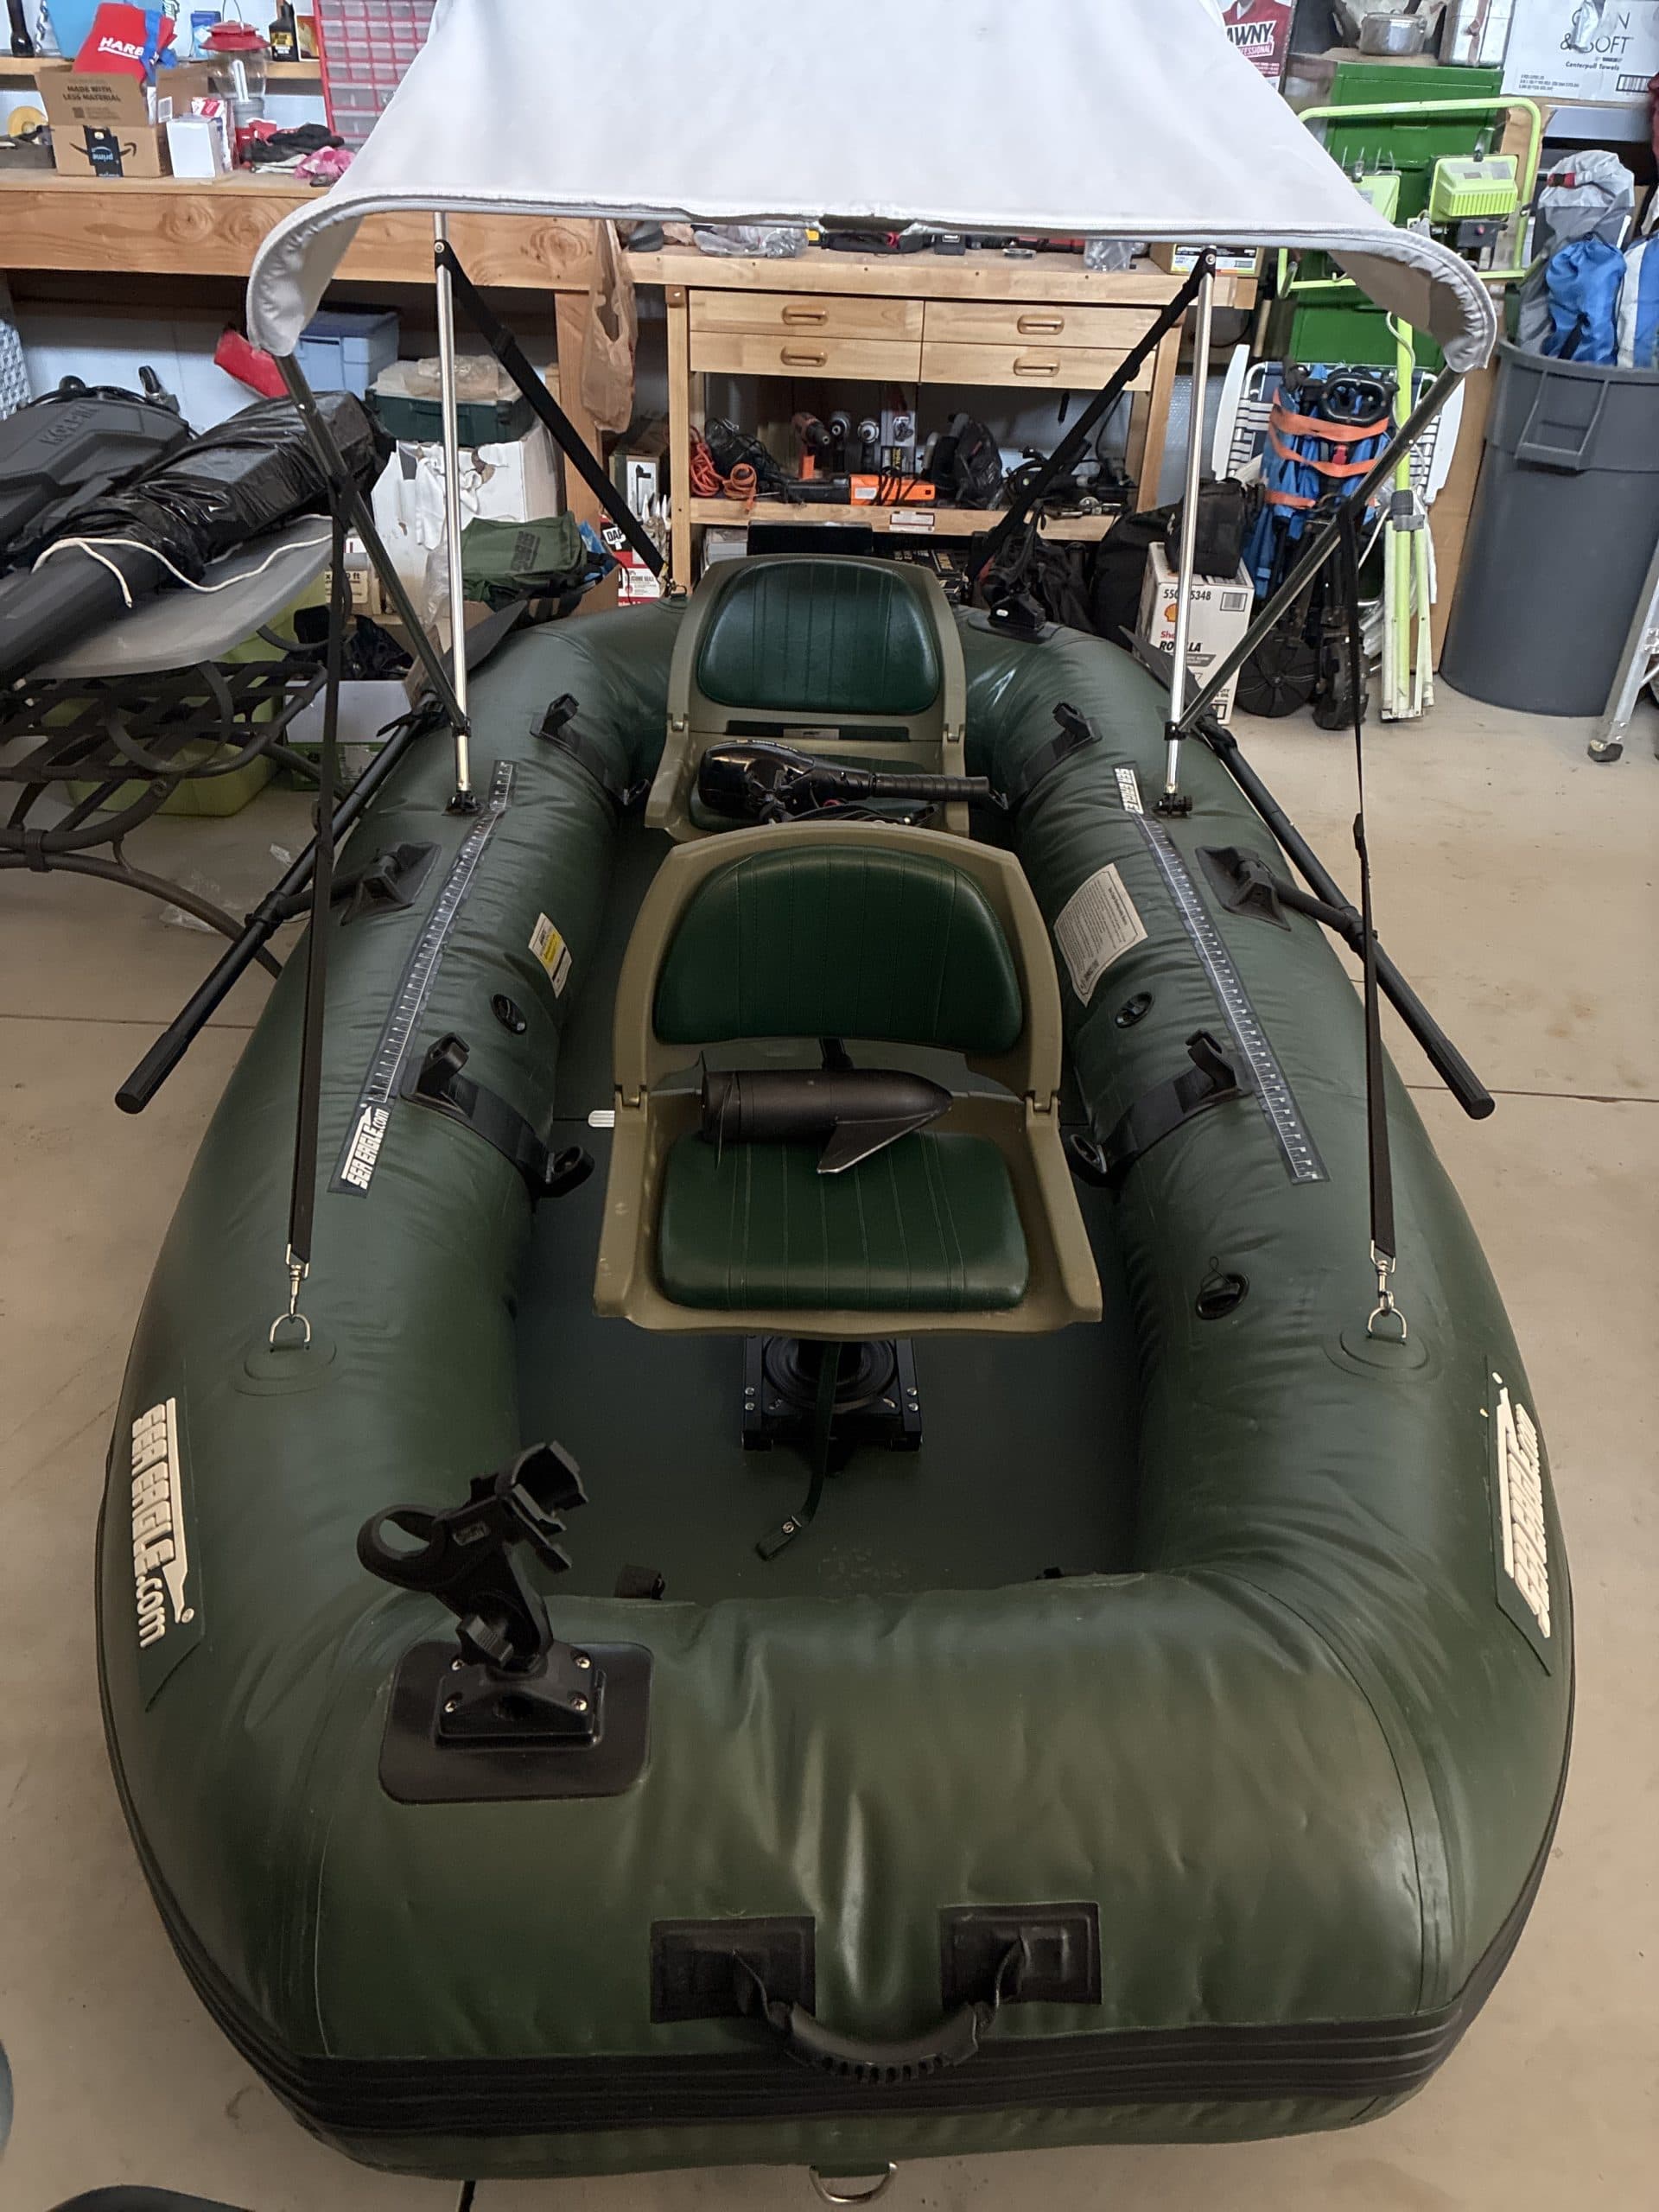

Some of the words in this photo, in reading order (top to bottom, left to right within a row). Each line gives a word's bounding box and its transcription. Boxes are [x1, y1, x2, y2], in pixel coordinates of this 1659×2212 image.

[99, 36, 145, 56] HARB
[1227, 22, 1274, 46] AWNY
[92, 153, 114, 162] prime
[1163, 588, 1211, 601] 5505348
[1160, 640, 1202, 652] ROLA
[354, 1108, 390, 1166] EAGLE.com
[346, 1158, 374, 1190] SEA
[131, 1403, 168, 1477] SEA
[131, 1461, 175, 1649] EAGLE.com
